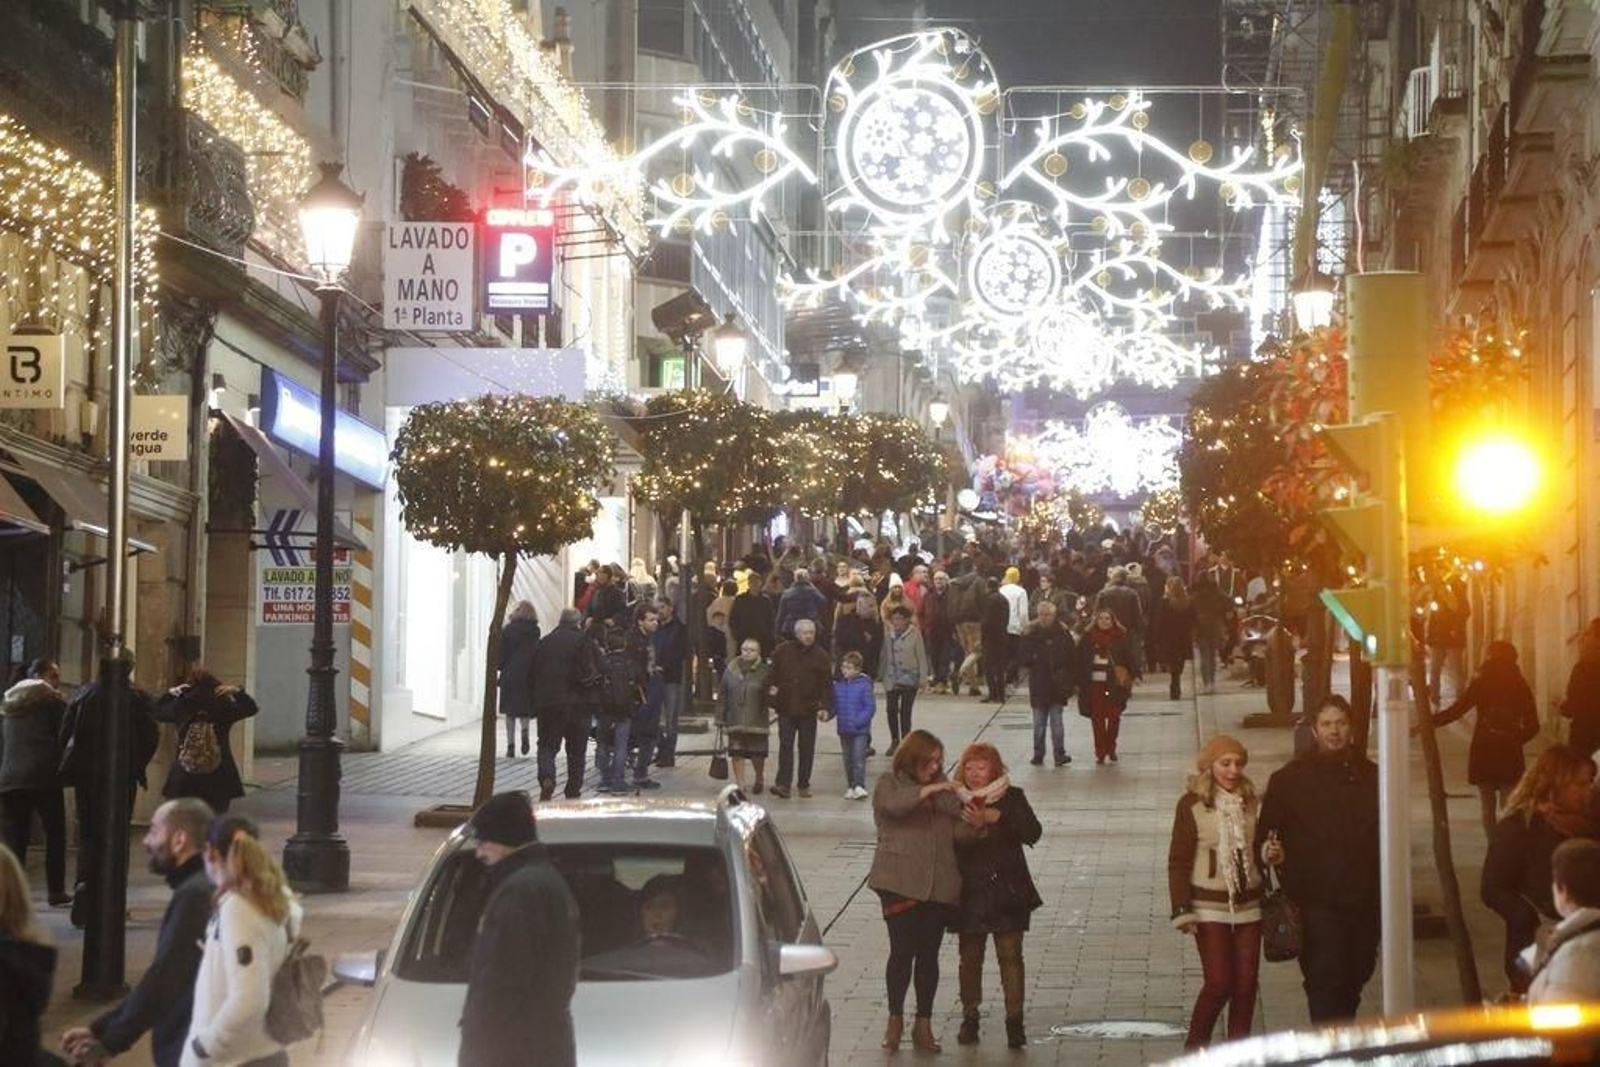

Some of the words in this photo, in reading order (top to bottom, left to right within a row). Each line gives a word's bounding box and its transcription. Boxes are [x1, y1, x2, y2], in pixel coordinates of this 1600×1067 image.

[389, 226, 469, 250] LAVADO
[422, 253, 435, 275] A
[500, 232, 537, 277] P
[398, 278, 459, 301] MANO
[413, 306, 463, 325] Planta
[264, 569, 305, 582] LAVADO
[284, 587, 304, 600] 617
[273, 603, 294, 612] UNA
[265, 613, 310, 622] PARKING
